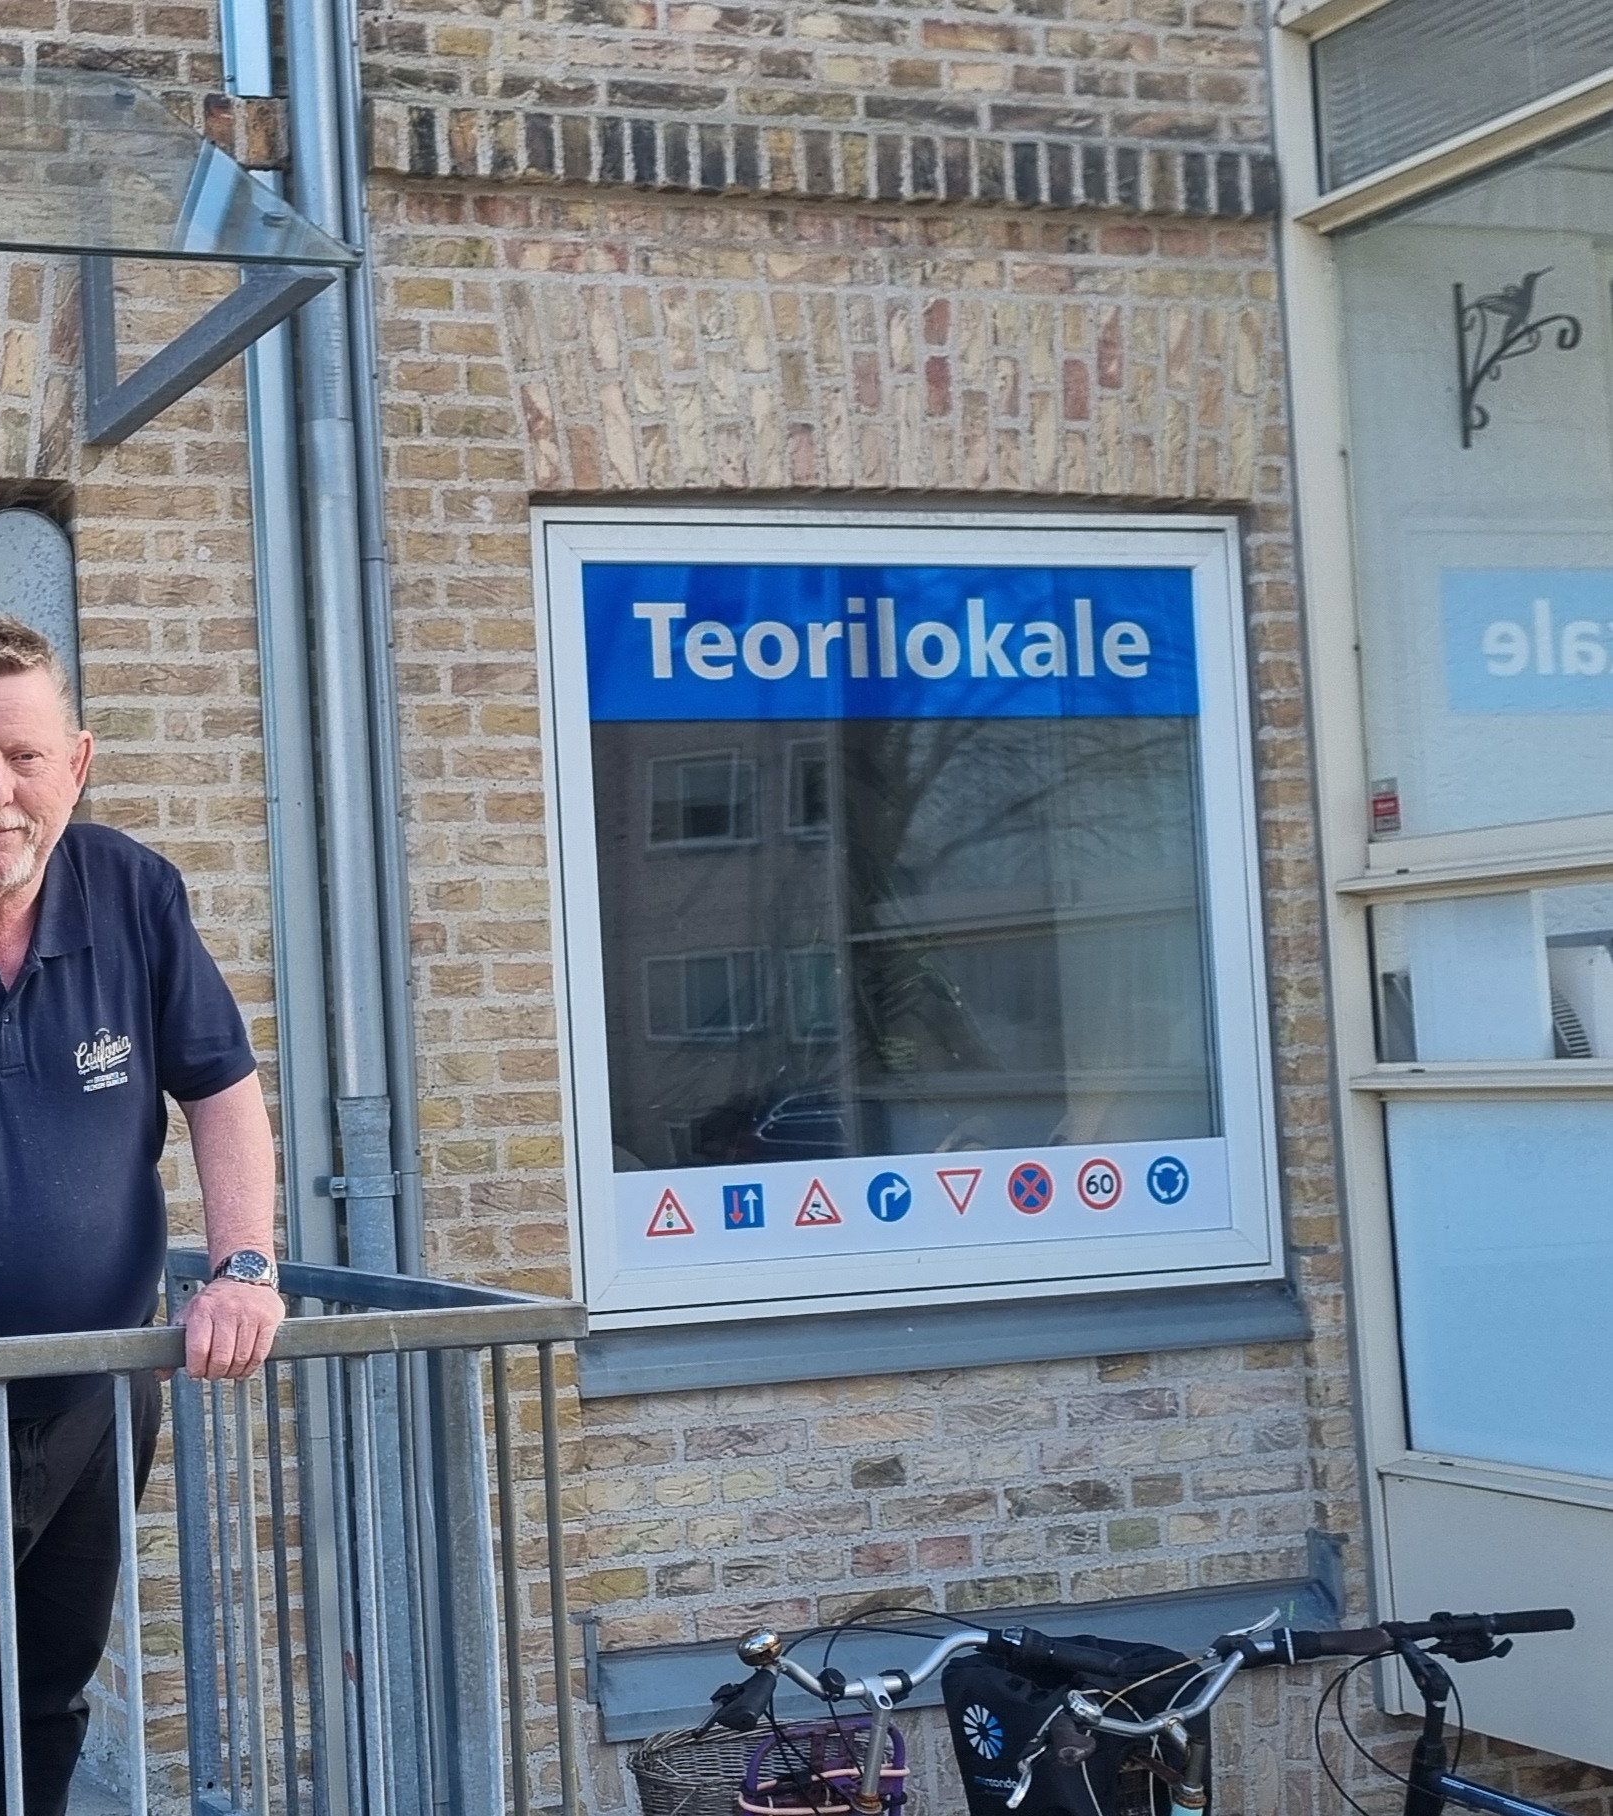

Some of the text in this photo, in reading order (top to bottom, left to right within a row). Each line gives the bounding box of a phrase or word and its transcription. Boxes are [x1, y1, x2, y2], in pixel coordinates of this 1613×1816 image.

[633, 597, 1150, 680] Teorilokale
[74, 1035, 131, 1072] California
[1086, 1174, 1114, 1195] 60
